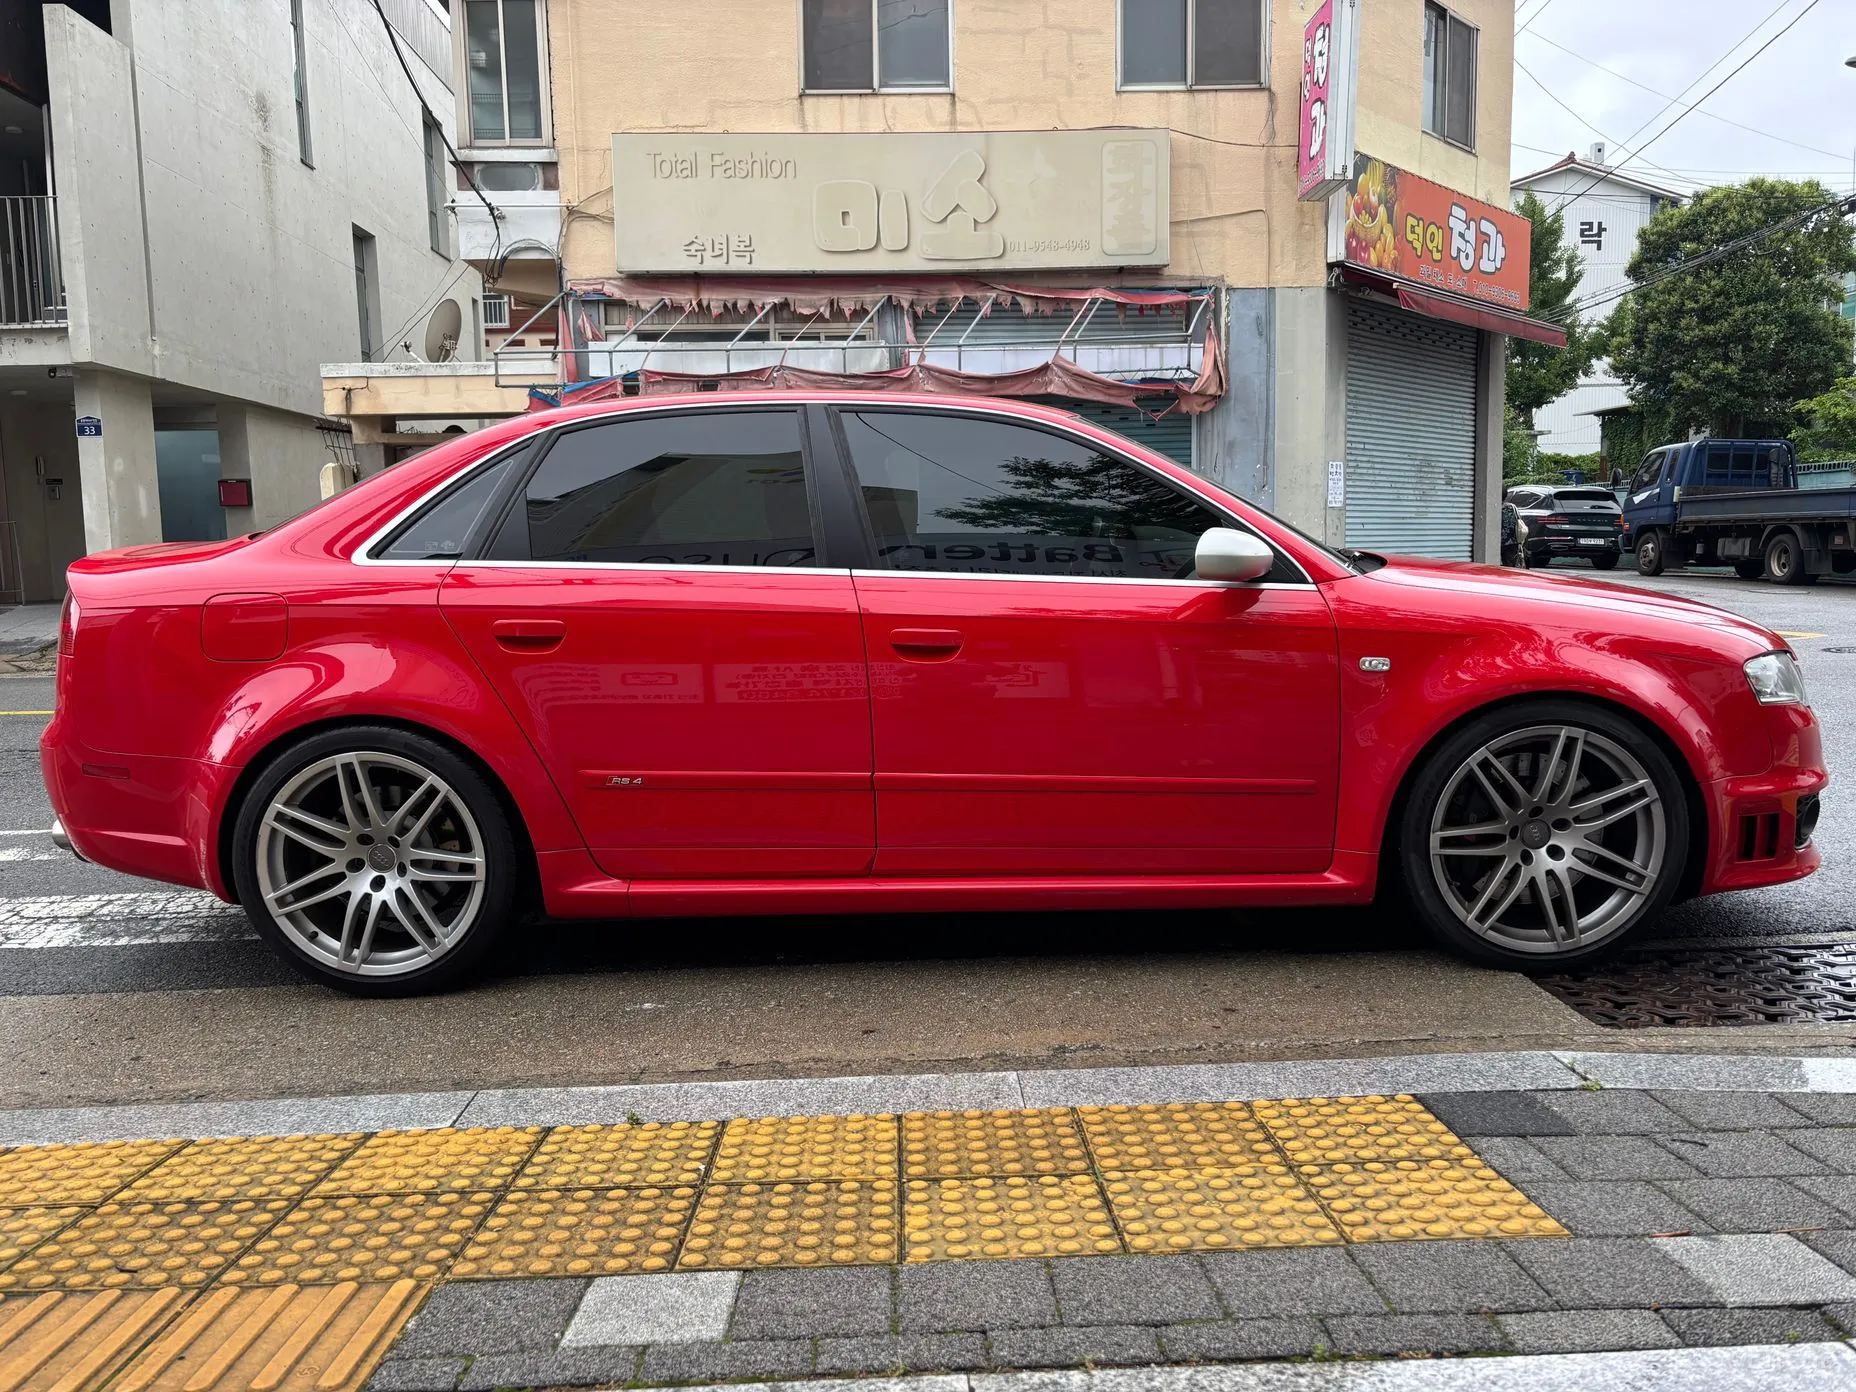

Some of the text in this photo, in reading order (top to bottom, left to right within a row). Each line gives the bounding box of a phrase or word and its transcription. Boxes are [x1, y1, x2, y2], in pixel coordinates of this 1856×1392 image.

[645, 151, 797, 179] Total Fashion
[812, 149, 1005, 261] 미소
[682, 234, 756, 265] 숙녀복
[1405, 202, 1506, 273] 덕인 청과
[1579, 221, 1607, 251] 락
[84, 426, 96, 435] 33
